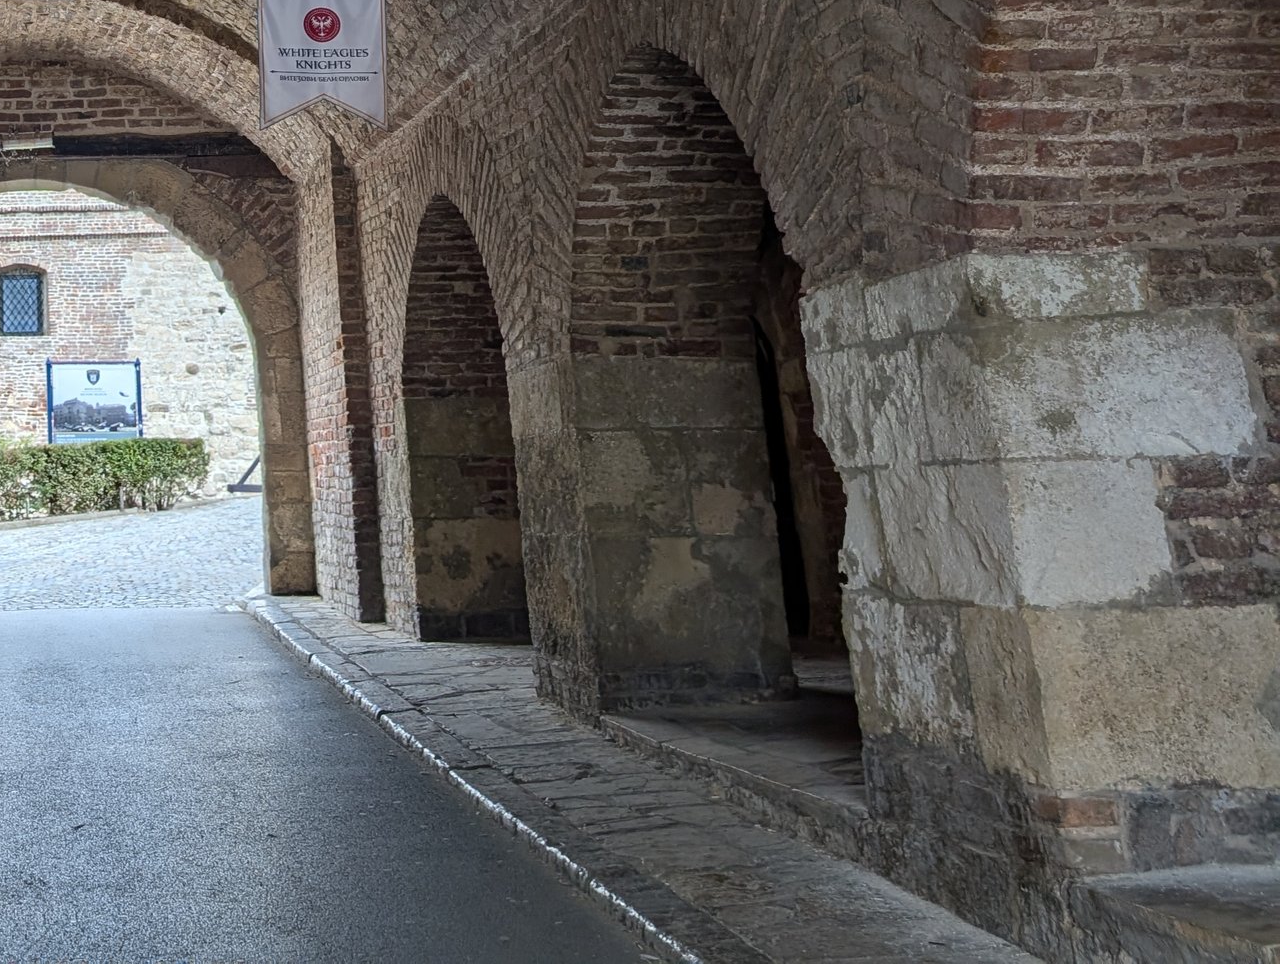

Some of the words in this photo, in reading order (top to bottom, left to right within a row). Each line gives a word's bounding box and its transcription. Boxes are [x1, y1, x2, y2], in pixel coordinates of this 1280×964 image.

[278, 47, 320, 58] WHITE
[323, 48, 369, 58] EAGLES
[295, 60, 351, 70] KNIGHTS
[279, 75, 317, 83] ВИТЕЗОВИ
[339, 75, 370, 83] ОРЛОВИ
